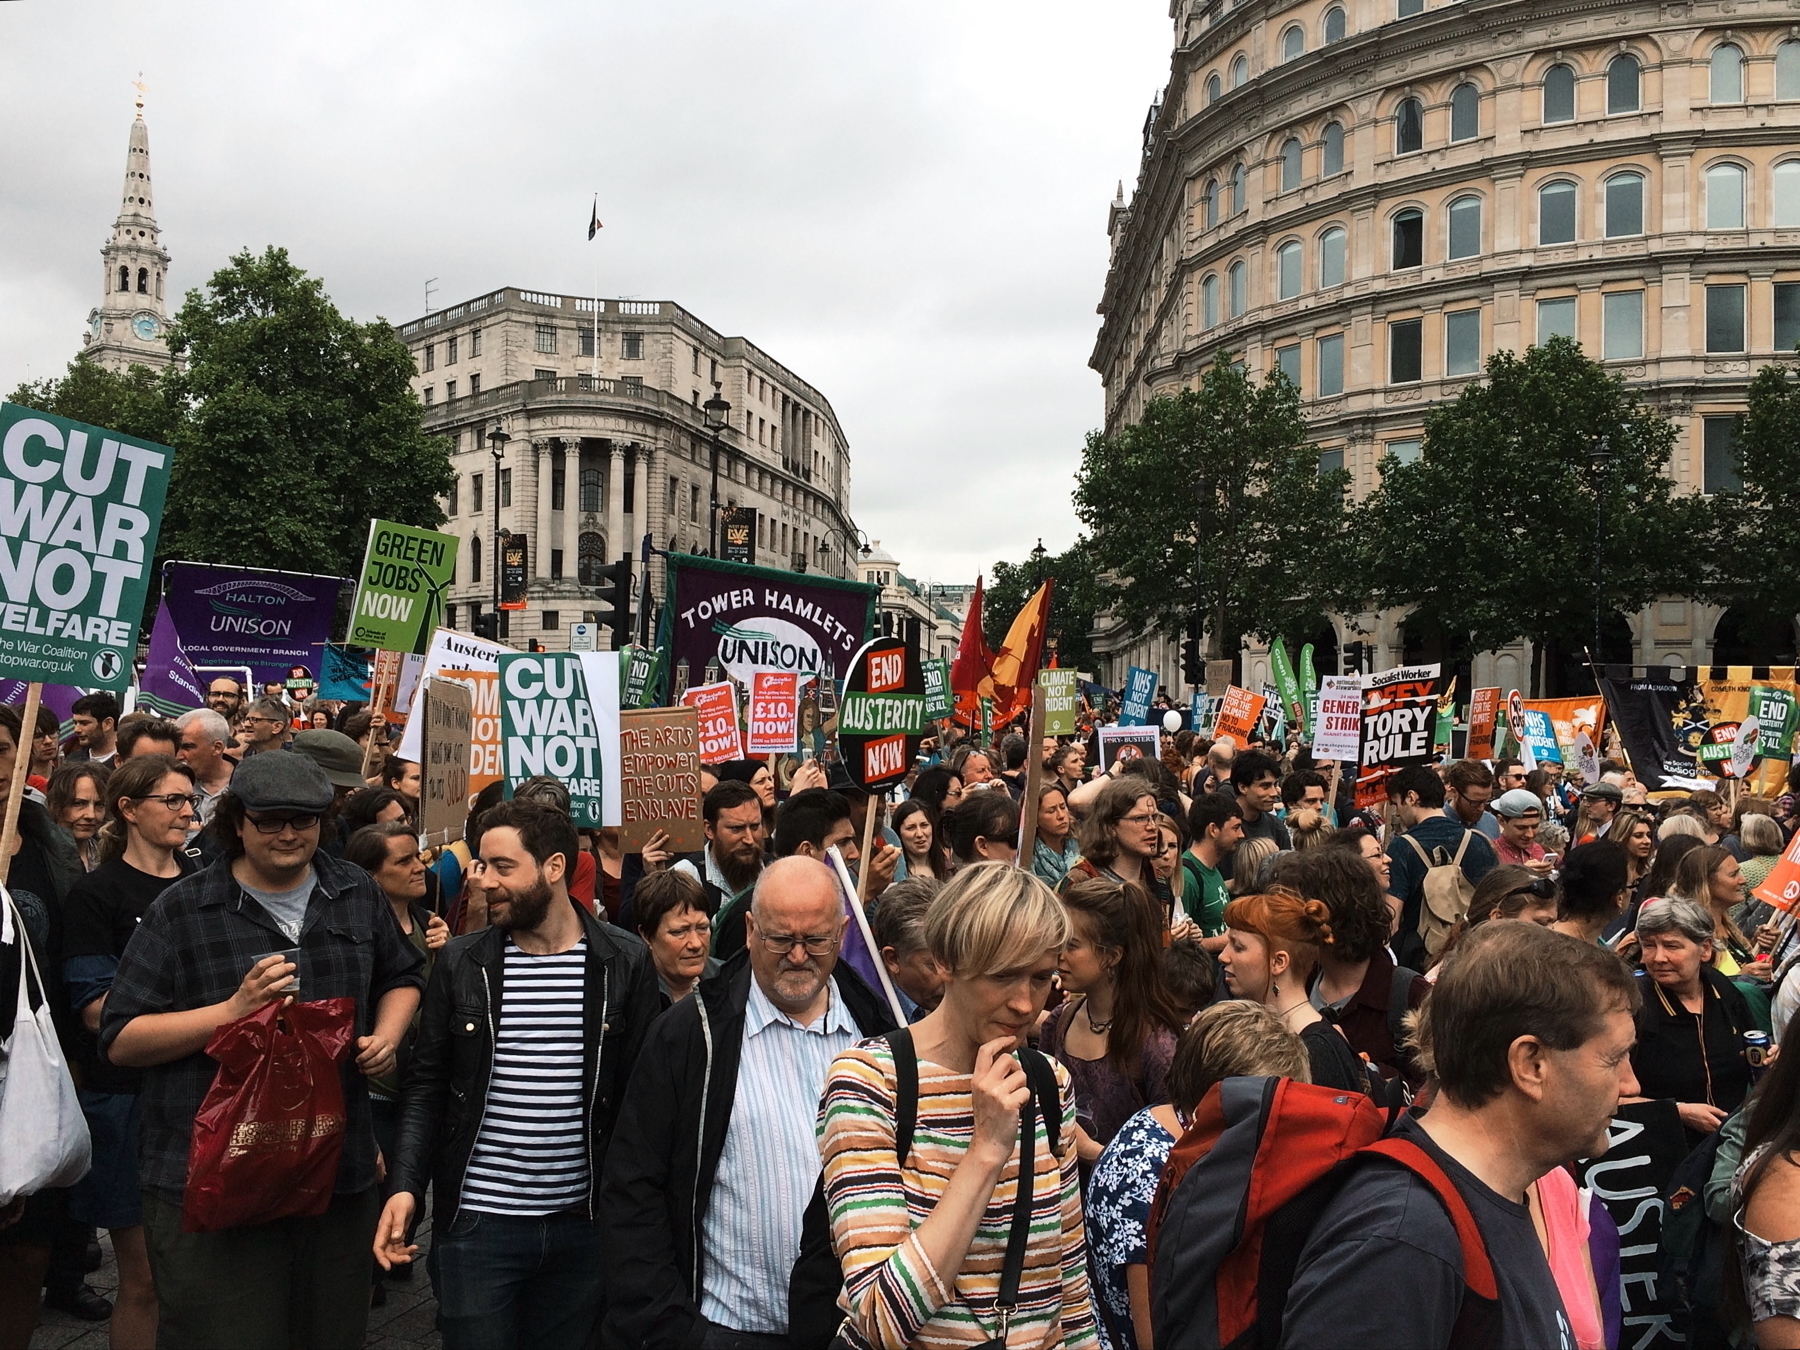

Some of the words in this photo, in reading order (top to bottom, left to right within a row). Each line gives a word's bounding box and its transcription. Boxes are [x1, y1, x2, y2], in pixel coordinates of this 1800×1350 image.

[3, 418, 166, 507] CUT
[0, 477, 150, 563] WAR
[375, 530, 446, 567] GREEN
[0, 535, 143, 618] NOT
[368, 560, 423, 593] JOBS
[226, 592, 286, 606] HALTON
[360, 590, 414, 623] NOW
[0, 602, 132, 648] ELFARE
[210, 615, 292, 636] UNISON
[681, 588, 756, 629] TOWER
[764, 588, 855, 651] HAMLETS
[0, 637, 14, 650] he
[17, 640, 39, 655] War
[42, 644, 88, 661] Coalition
[212, 645, 270, 655] GOVERNMENT
[272, 648, 309, 656] BRANCH
[441, 636, 501, 664] Austeri
[721, 638, 817, 672] UNISON
[0, 652, 74, 673] topwar.org.uk
[200, 657, 233, 666] Together
[260, 660, 293, 668] Stronger
[632, 660, 650, 679] ND
[1275, 648, 1287, 676] Green
[292, 668, 304, 678] END
[505, 657, 585, 699] CUT
[871, 654, 901, 689] END
[1040, 671, 1075, 687] CLIMATE
[1372, 671, 1401, 687] Socialist
[1400, 669, 1432, 681] Worker
[168, 669, 205, 704] Standing
[286, 678, 313, 689] AUSTERITY
[1047, 685, 1067, 697] NOT
[1132, 671, 1153, 694] NHS
[294, 688, 308, 700] NOW
[1130, 690, 1148, 704] NOT
[1228, 687, 1244, 700] RISE
[1243, 691, 1253, 703] UP
[1475, 691, 1485, 701] RISE
[1484, 691, 1492, 701] UP
[1754, 690, 1772, 698] Green
[1782, 694, 1796, 702] Party
[926, 702, 936, 713] US
[937, 702, 948, 712] ALL
[1045, 696, 1074, 712] RIDENT
[1123, 700, 1149, 720] TRIDENT
[1223, 704, 1250, 721] CLIMATE
[1225, 695, 1239, 706] FOR
[1239, 700, 1252, 712] THE
[1322, 699, 1360, 715] GENER
[1482, 701, 1492, 712] THE
[1759, 700, 1788, 721] END
[506, 699, 597, 736] WAR
[842, 697, 924, 731] AUSTERITY
[1221, 713, 1230, 723] NO
[1230, 716, 1239, 726] TO
[1472, 712, 1491, 725] CLIMATE
[1524, 711, 1546, 729] NHS
[752, 718, 795, 735] now!
[1217, 721, 1248, 738] FRACKING
[1325, 716, 1360, 732] STRIK
[1364, 706, 1432, 741] TORY
[1528, 727, 1547, 737] NOT
[1759, 718, 1784, 729] AUSTERITY
[619, 727, 651, 751] THE
[654, 726, 694, 748] ARTS
[1124, 735, 1155, 743] BUSTERS
[1527, 734, 1556, 750] RIDENT
[1714, 726, 1737, 743] END
[1767, 738, 1781, 749] ALL
[508, 734, 599, 778] NOT
[1363, 731, 1428, 767] RULE
[867, 739, 904, 778] NOW
[1672, 760, 1694, 768] Society
[446, 767, 467, 808] SOLD
[510, 776, 600, 798] WFARE
[621, 775, 655, 798] THE
[655, 772, 698, 797] CUTS
[624, 796, 698, 823] ENSLAVE
